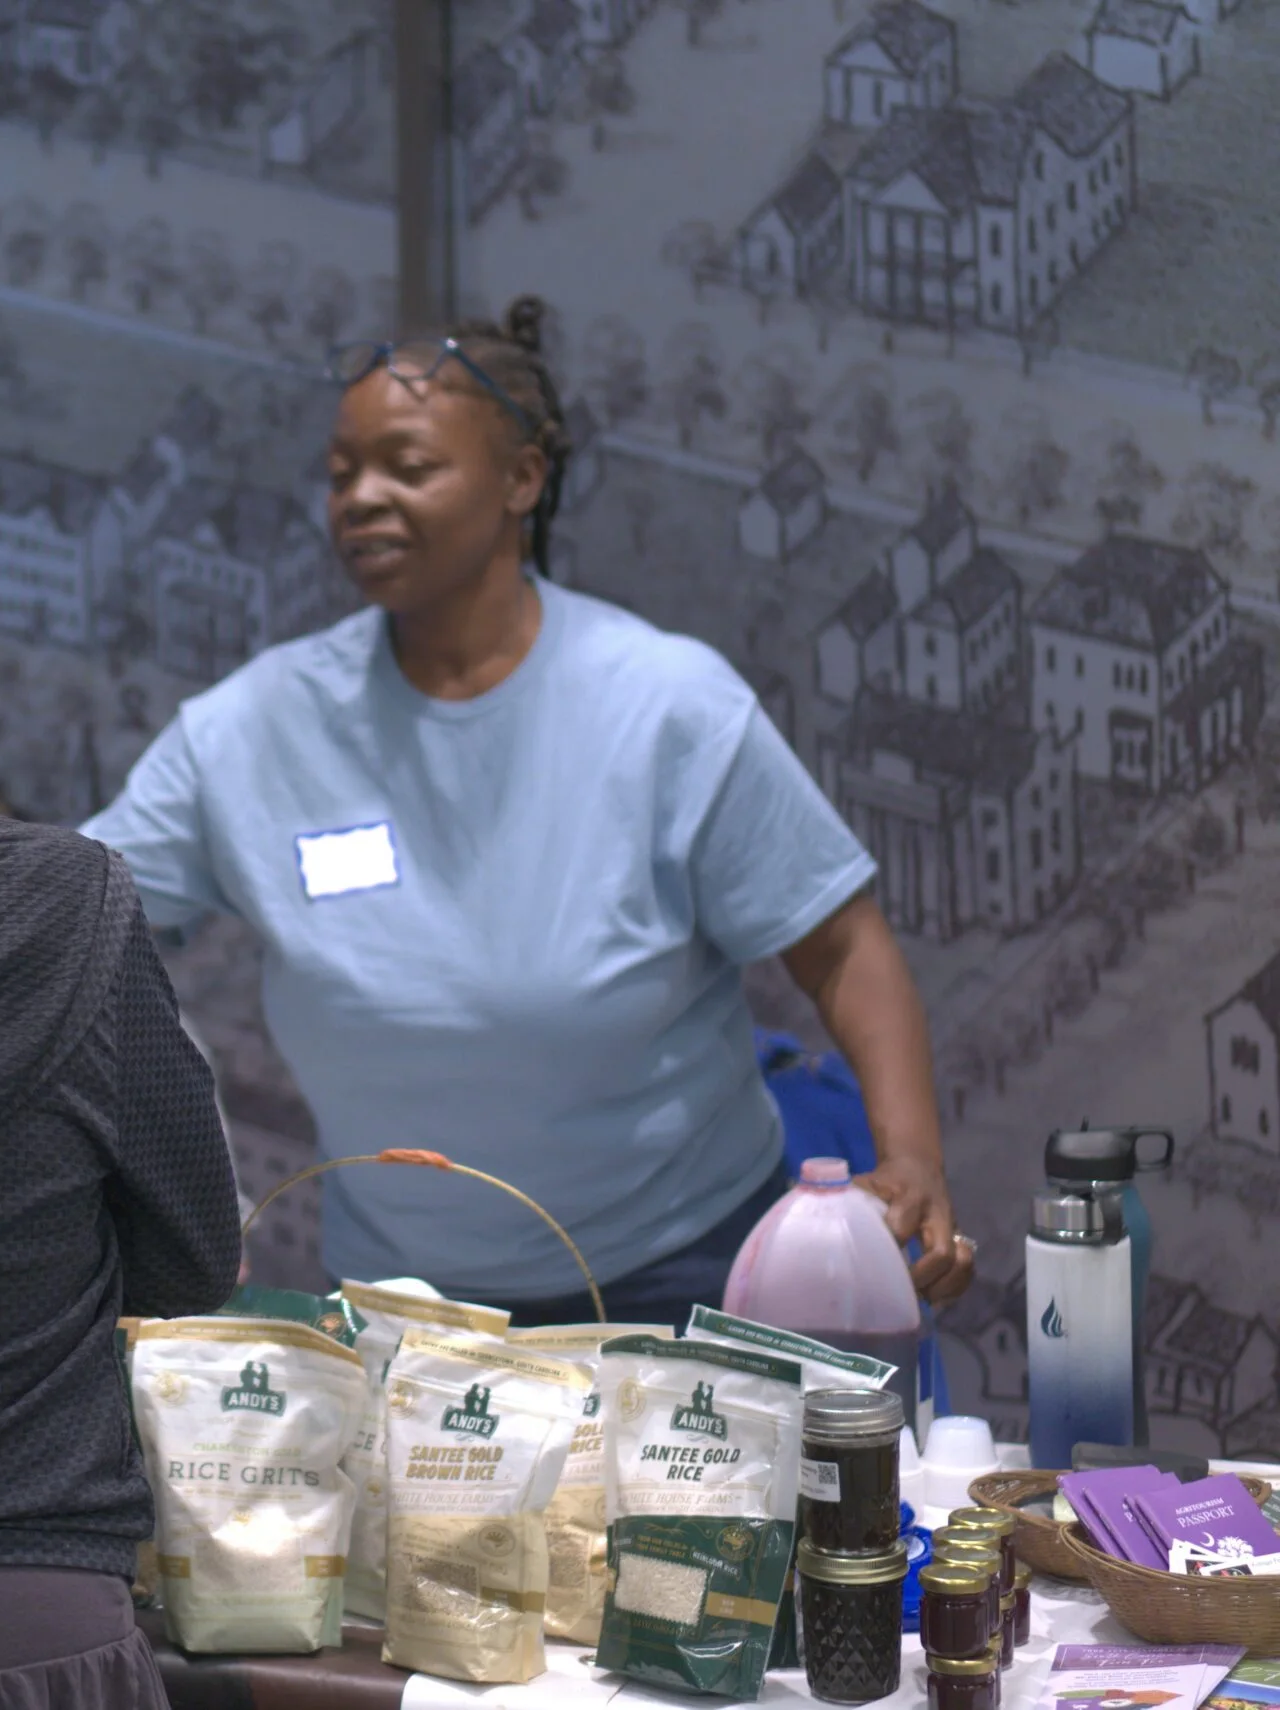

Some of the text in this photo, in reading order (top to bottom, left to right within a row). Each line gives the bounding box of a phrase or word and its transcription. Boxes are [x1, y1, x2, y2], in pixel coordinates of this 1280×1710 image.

[228, 1392, 279, 1411] ANDY'S
[448, 1412, 492, 1435] ANDY'S
[678, 1412, 724, 1435] ANDY'S
[408, 1446, 465, 1463] SANTEE
[467, 1446, 505, 1463] GOLD
[640, 1444, 742, 1465] SANTEE GOLD
[167, 1460, 320, 1487] RICE GRITS
[405, 1463, 498, 1482] BROWN RICE
[666, 1464, 705, 1482] RICE
[1176, 1505, 1236, 1529] PASSPORT
[724, 1562, 739, 1576] RICE
